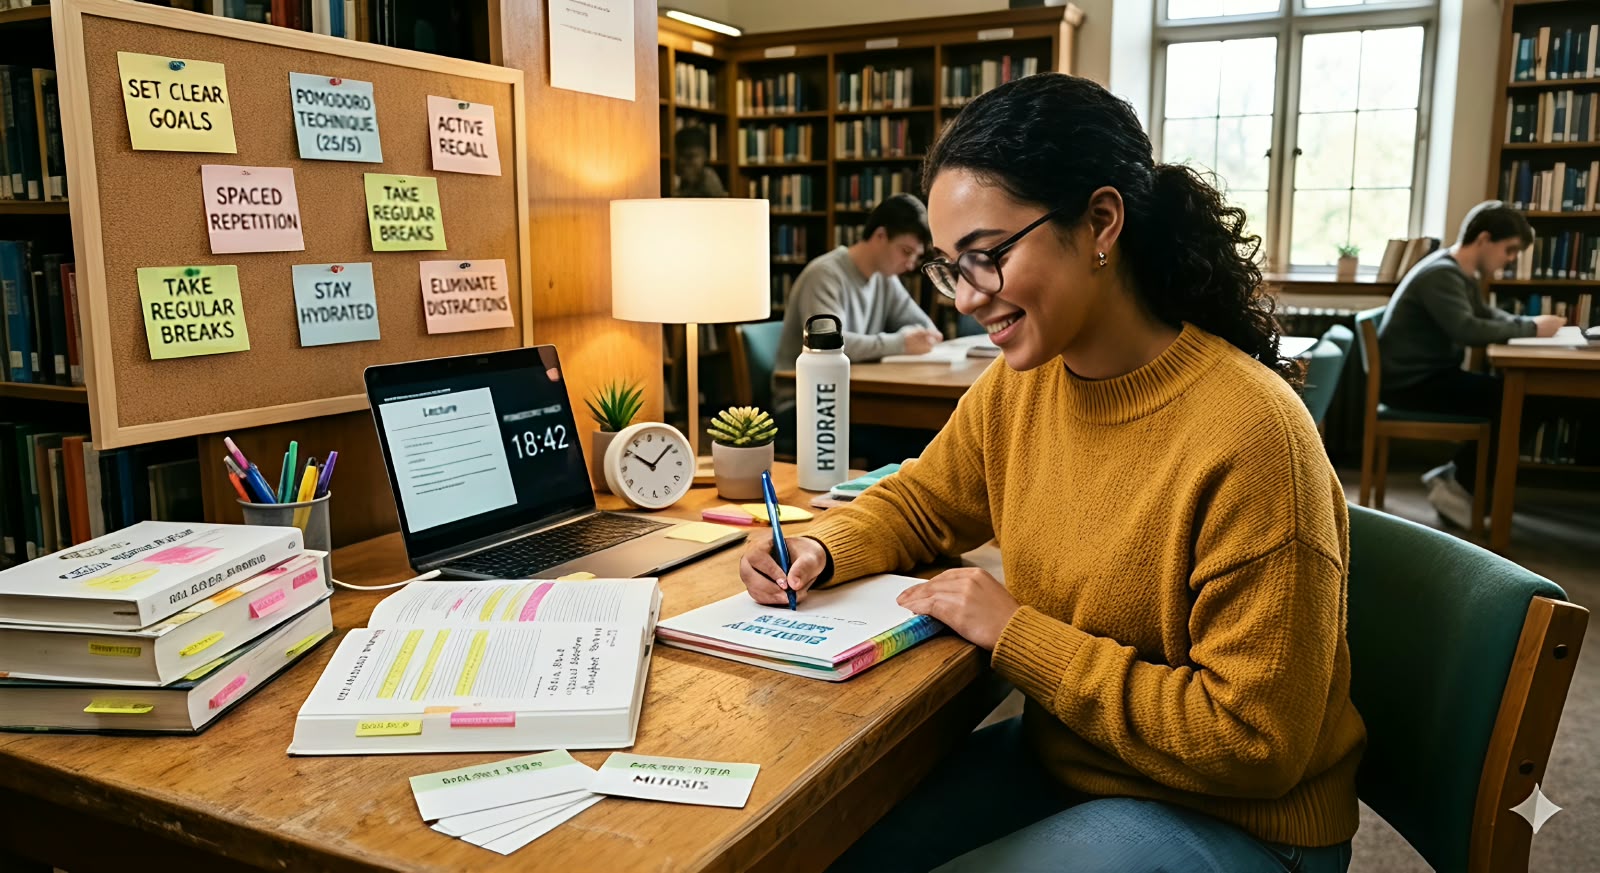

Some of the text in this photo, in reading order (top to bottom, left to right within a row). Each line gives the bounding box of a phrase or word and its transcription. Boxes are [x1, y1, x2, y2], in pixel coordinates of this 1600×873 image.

[128, 79, 225, 104] SET CLEAR
[296, 89, 371, 111] POMODORO
[149, 108, 213, 131] GOALS
[298, 111, 375, 132] TECHNIQUE
[438, 116, 484, 137] ACTIVE
[316, 134, 362, 154] (25/5)
[439, 138, 488, 158] RECALL
[216, 187, 283, 205] SPACED
[383, 186, 419, 203] TAKE
[210, 213, 298, 231] REPETITION
[373, 205, 435, 222] REGULAR
[380, 226, 434, 242] BREAKS
[163, 277, 213, 296] TAKE
[314, 281, 352, 299] STAY
[430, 276, 497, 294] ELIMINATE
[151, 298, 236, 320] REGULAR
[301, 303, 375, 324] HYDRATED
[427, 296, 508, 316] DISTRACTIONS
[161, 321, 235, 344] BREAKS
[422, 404, 458, 418] Lecture
[816, 383, 836, 471] HYDRATE
[511, 424, 569, 460] 18:42
